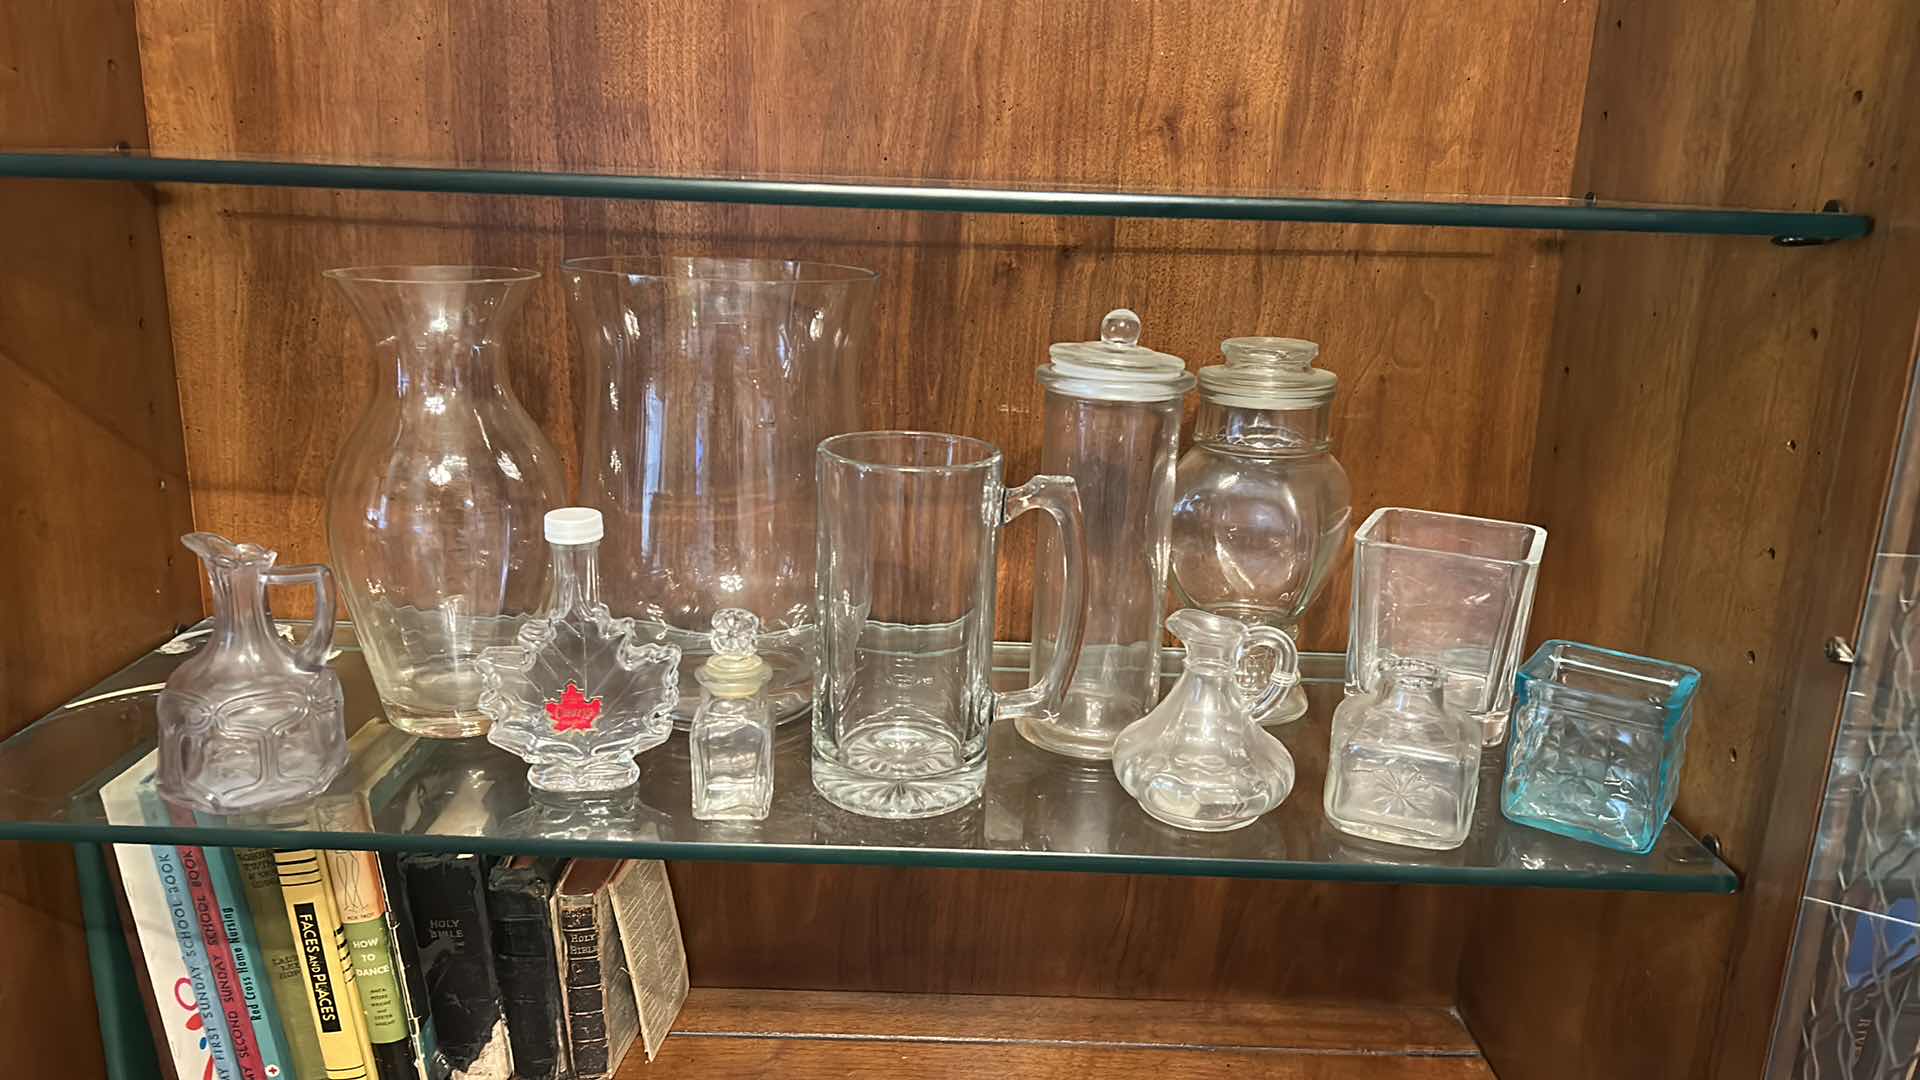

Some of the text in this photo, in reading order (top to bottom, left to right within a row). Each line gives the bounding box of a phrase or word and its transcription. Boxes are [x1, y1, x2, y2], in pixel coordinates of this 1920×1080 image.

[158, 854, 179, 893] BOOK
[183, 851, 201, 887] BOOK
[172, 901, 197, 957] SCHOOL
[196, 895, 218, 945] SCHOOL
[430, 919, 460, 928] HOLY
[571, 934, 596, 943] HOLY
[352, 937, 378, 949] HOW
[361, 953, 376, 962] TO
[211, 954, 234, 1003] SUNDAY
[222, 907, 262, 1021] Red Cross Home Nursing
[299, 914, 336, 1021] FACES AND PLACES
[356, 964, 390, 977] DANCE
[190, 966, 213, 1019] SUNDAY
[207, 1027, 224, 1060] FIRST
[228, 1010, 250, 1058] SECOND
